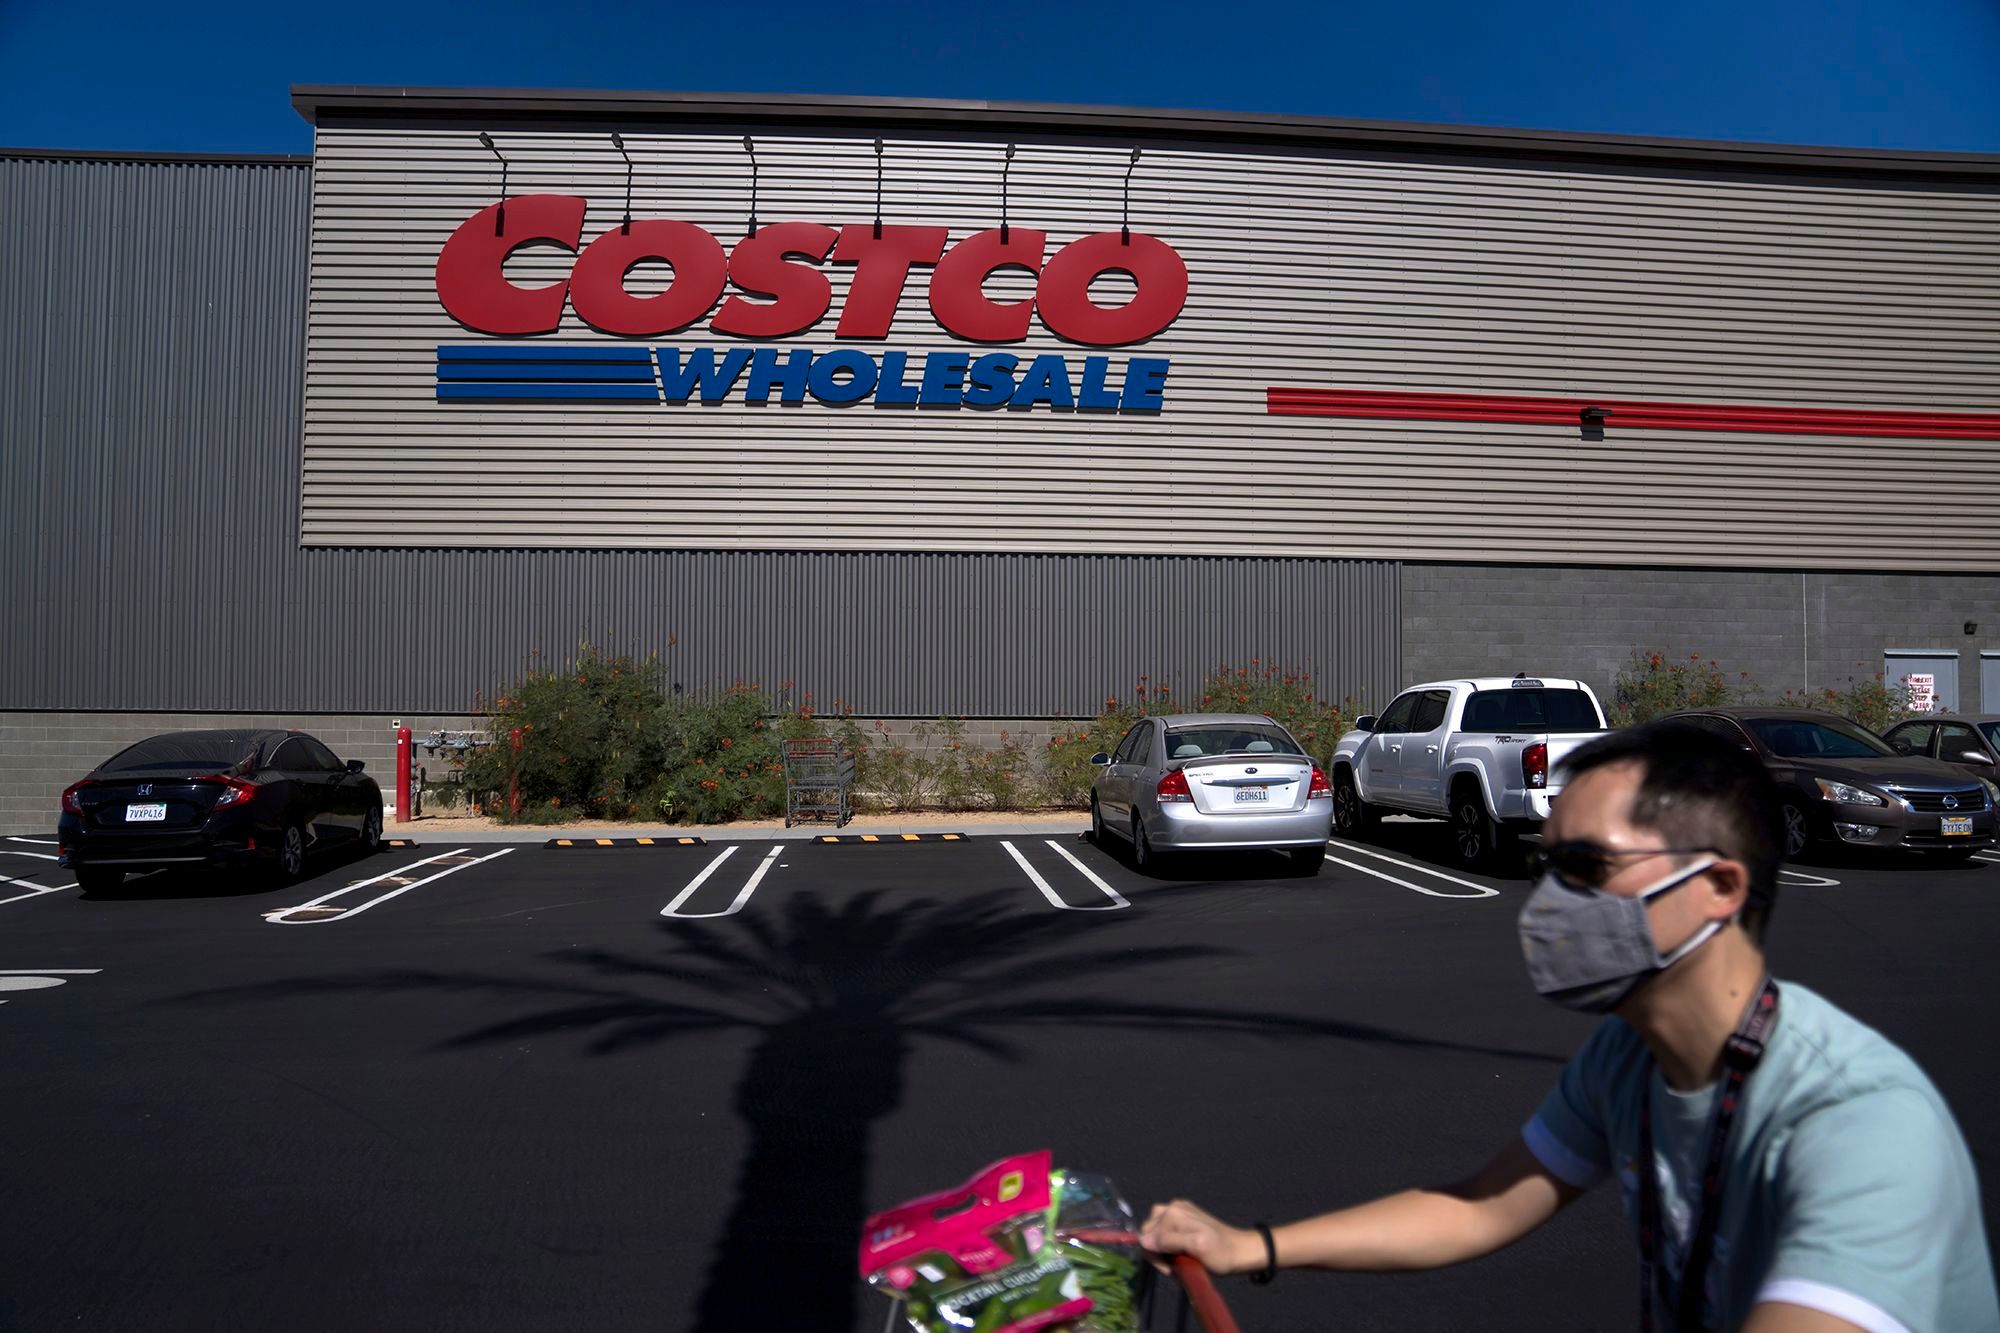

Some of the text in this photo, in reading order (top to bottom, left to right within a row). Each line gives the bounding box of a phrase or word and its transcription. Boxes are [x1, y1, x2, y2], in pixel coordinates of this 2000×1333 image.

[435, 193, 1189, 345] COSTCO
[655, 347, 1170, 414] WHOLESALE
[129, 808, 163, 819] 7VXP416
[1236, 791, 1267, 801] 6EDH611
